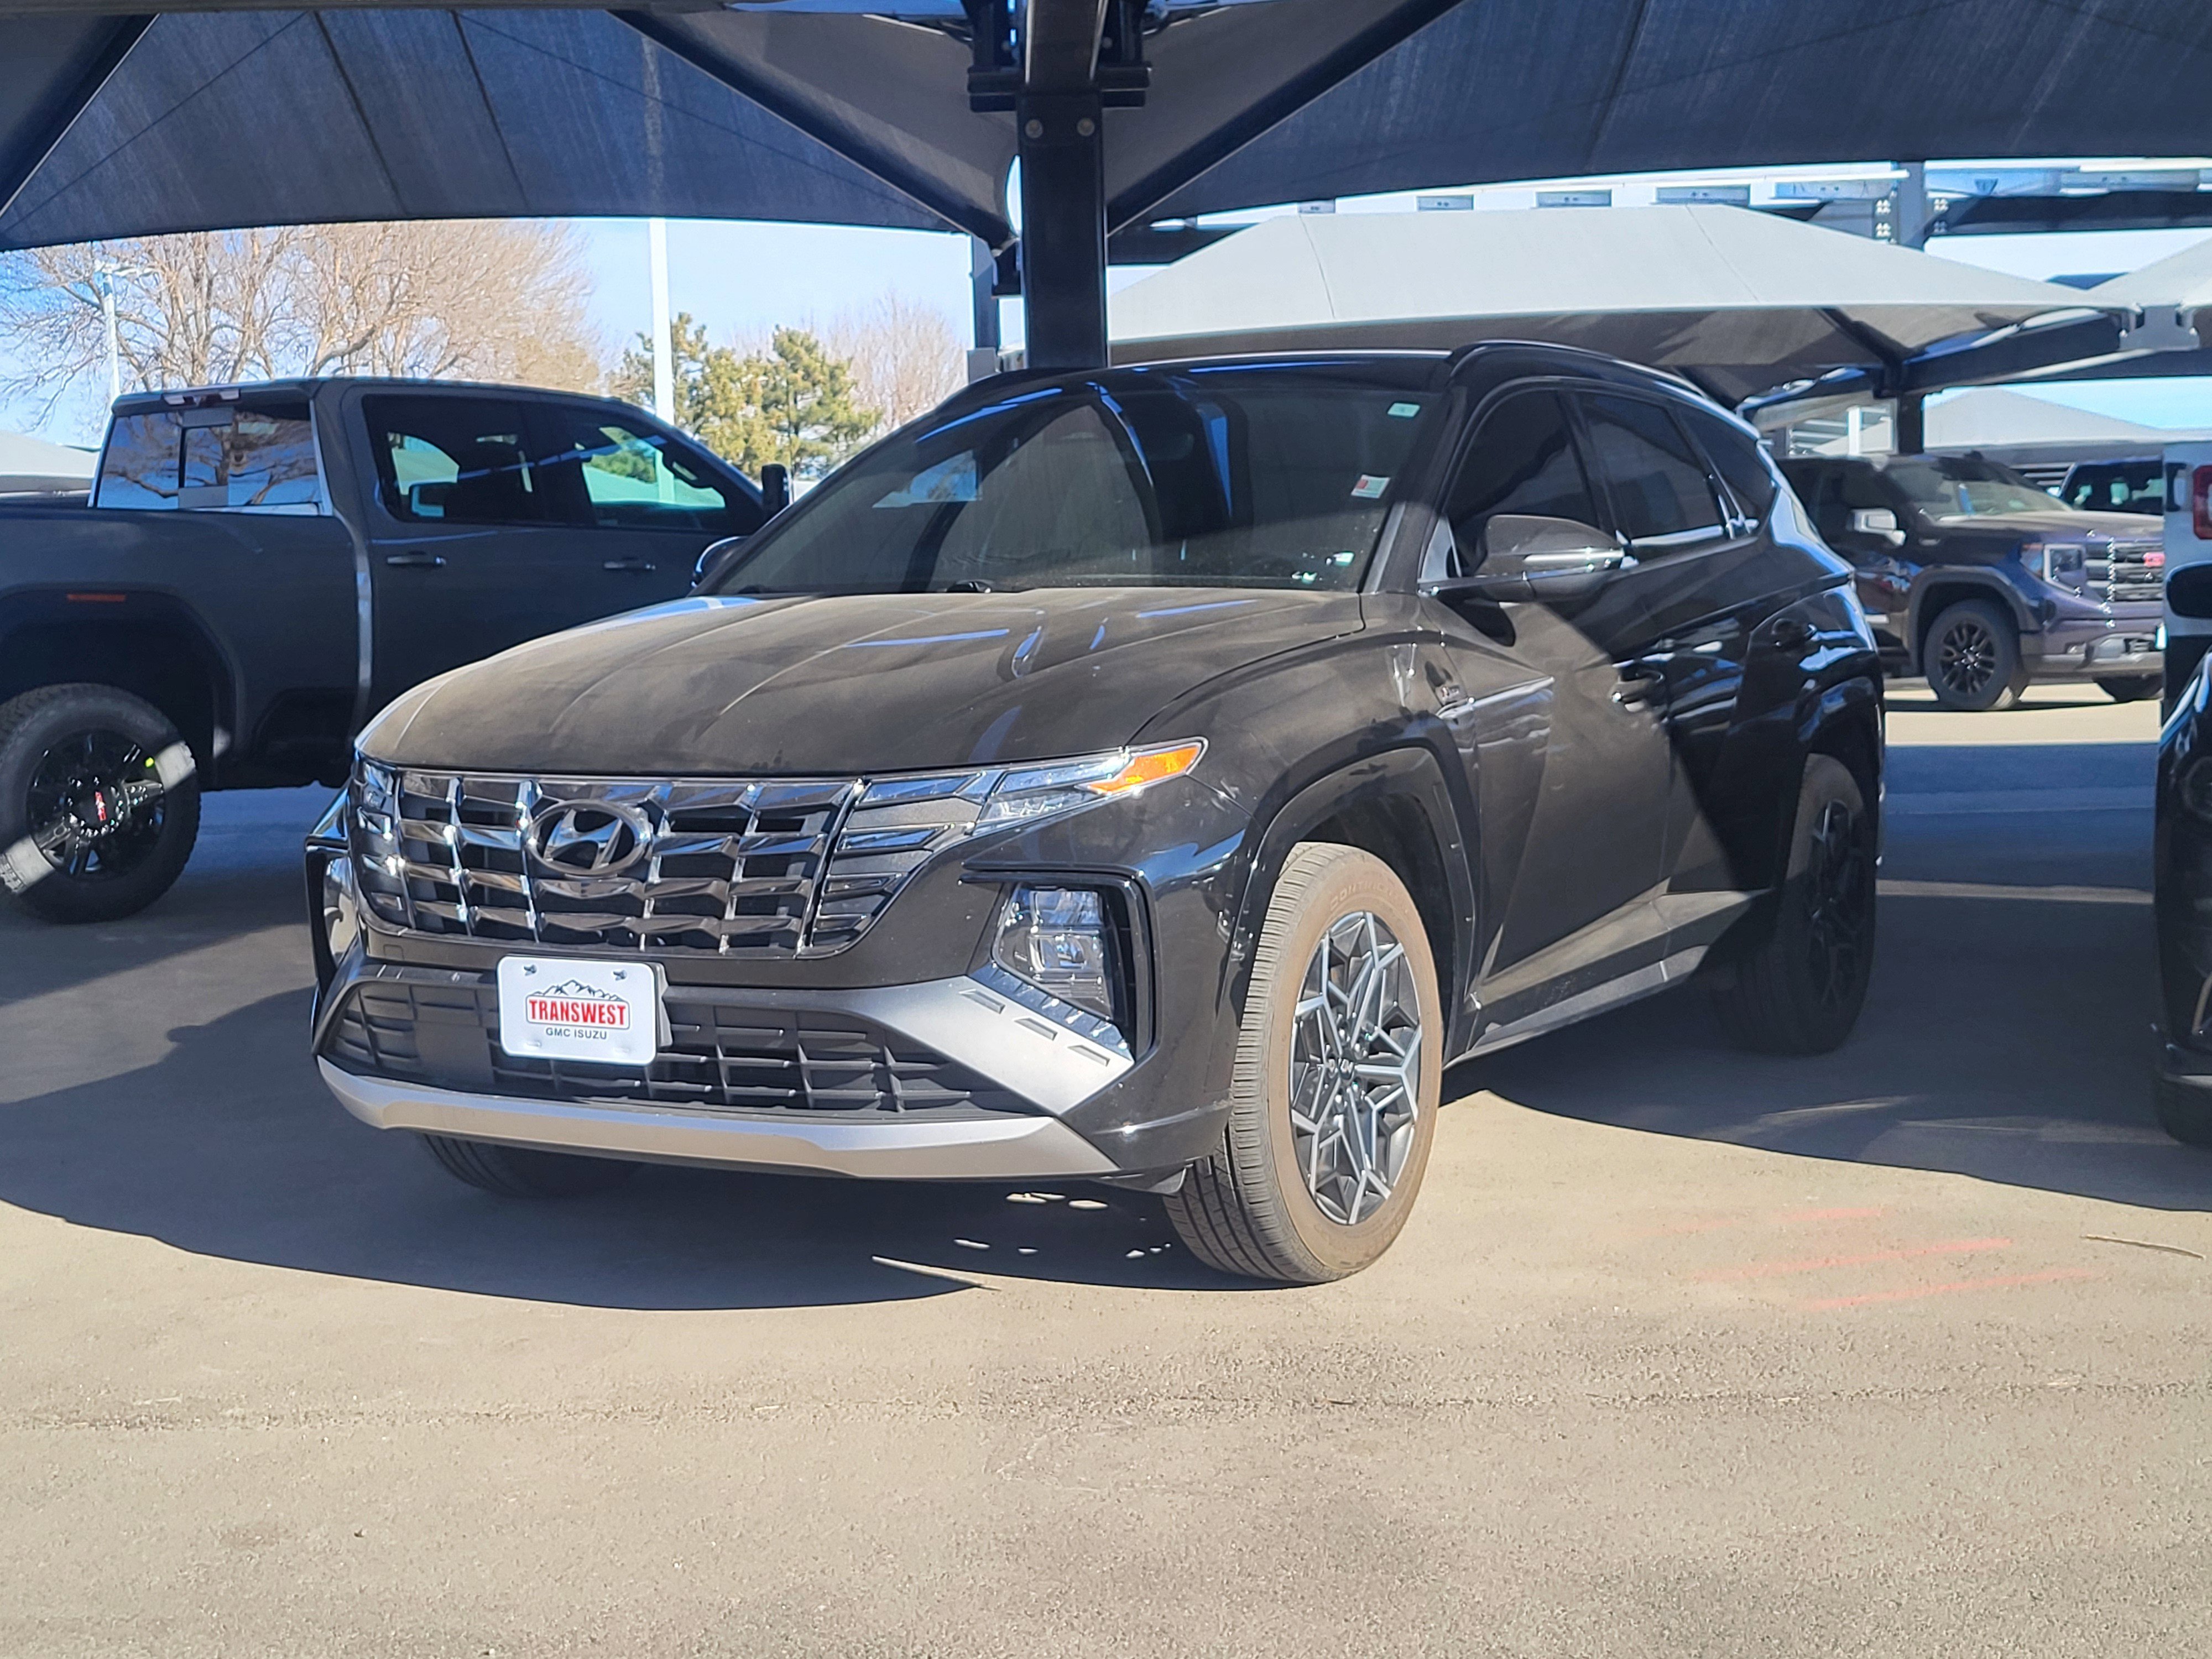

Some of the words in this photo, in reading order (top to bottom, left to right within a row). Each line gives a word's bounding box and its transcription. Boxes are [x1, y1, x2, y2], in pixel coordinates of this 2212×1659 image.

[529, 999, 626, 1025] TRANSWEST
[545, 1027, 571, 1037] GMC
[574, 1029, 607, 1040] ISUZU
